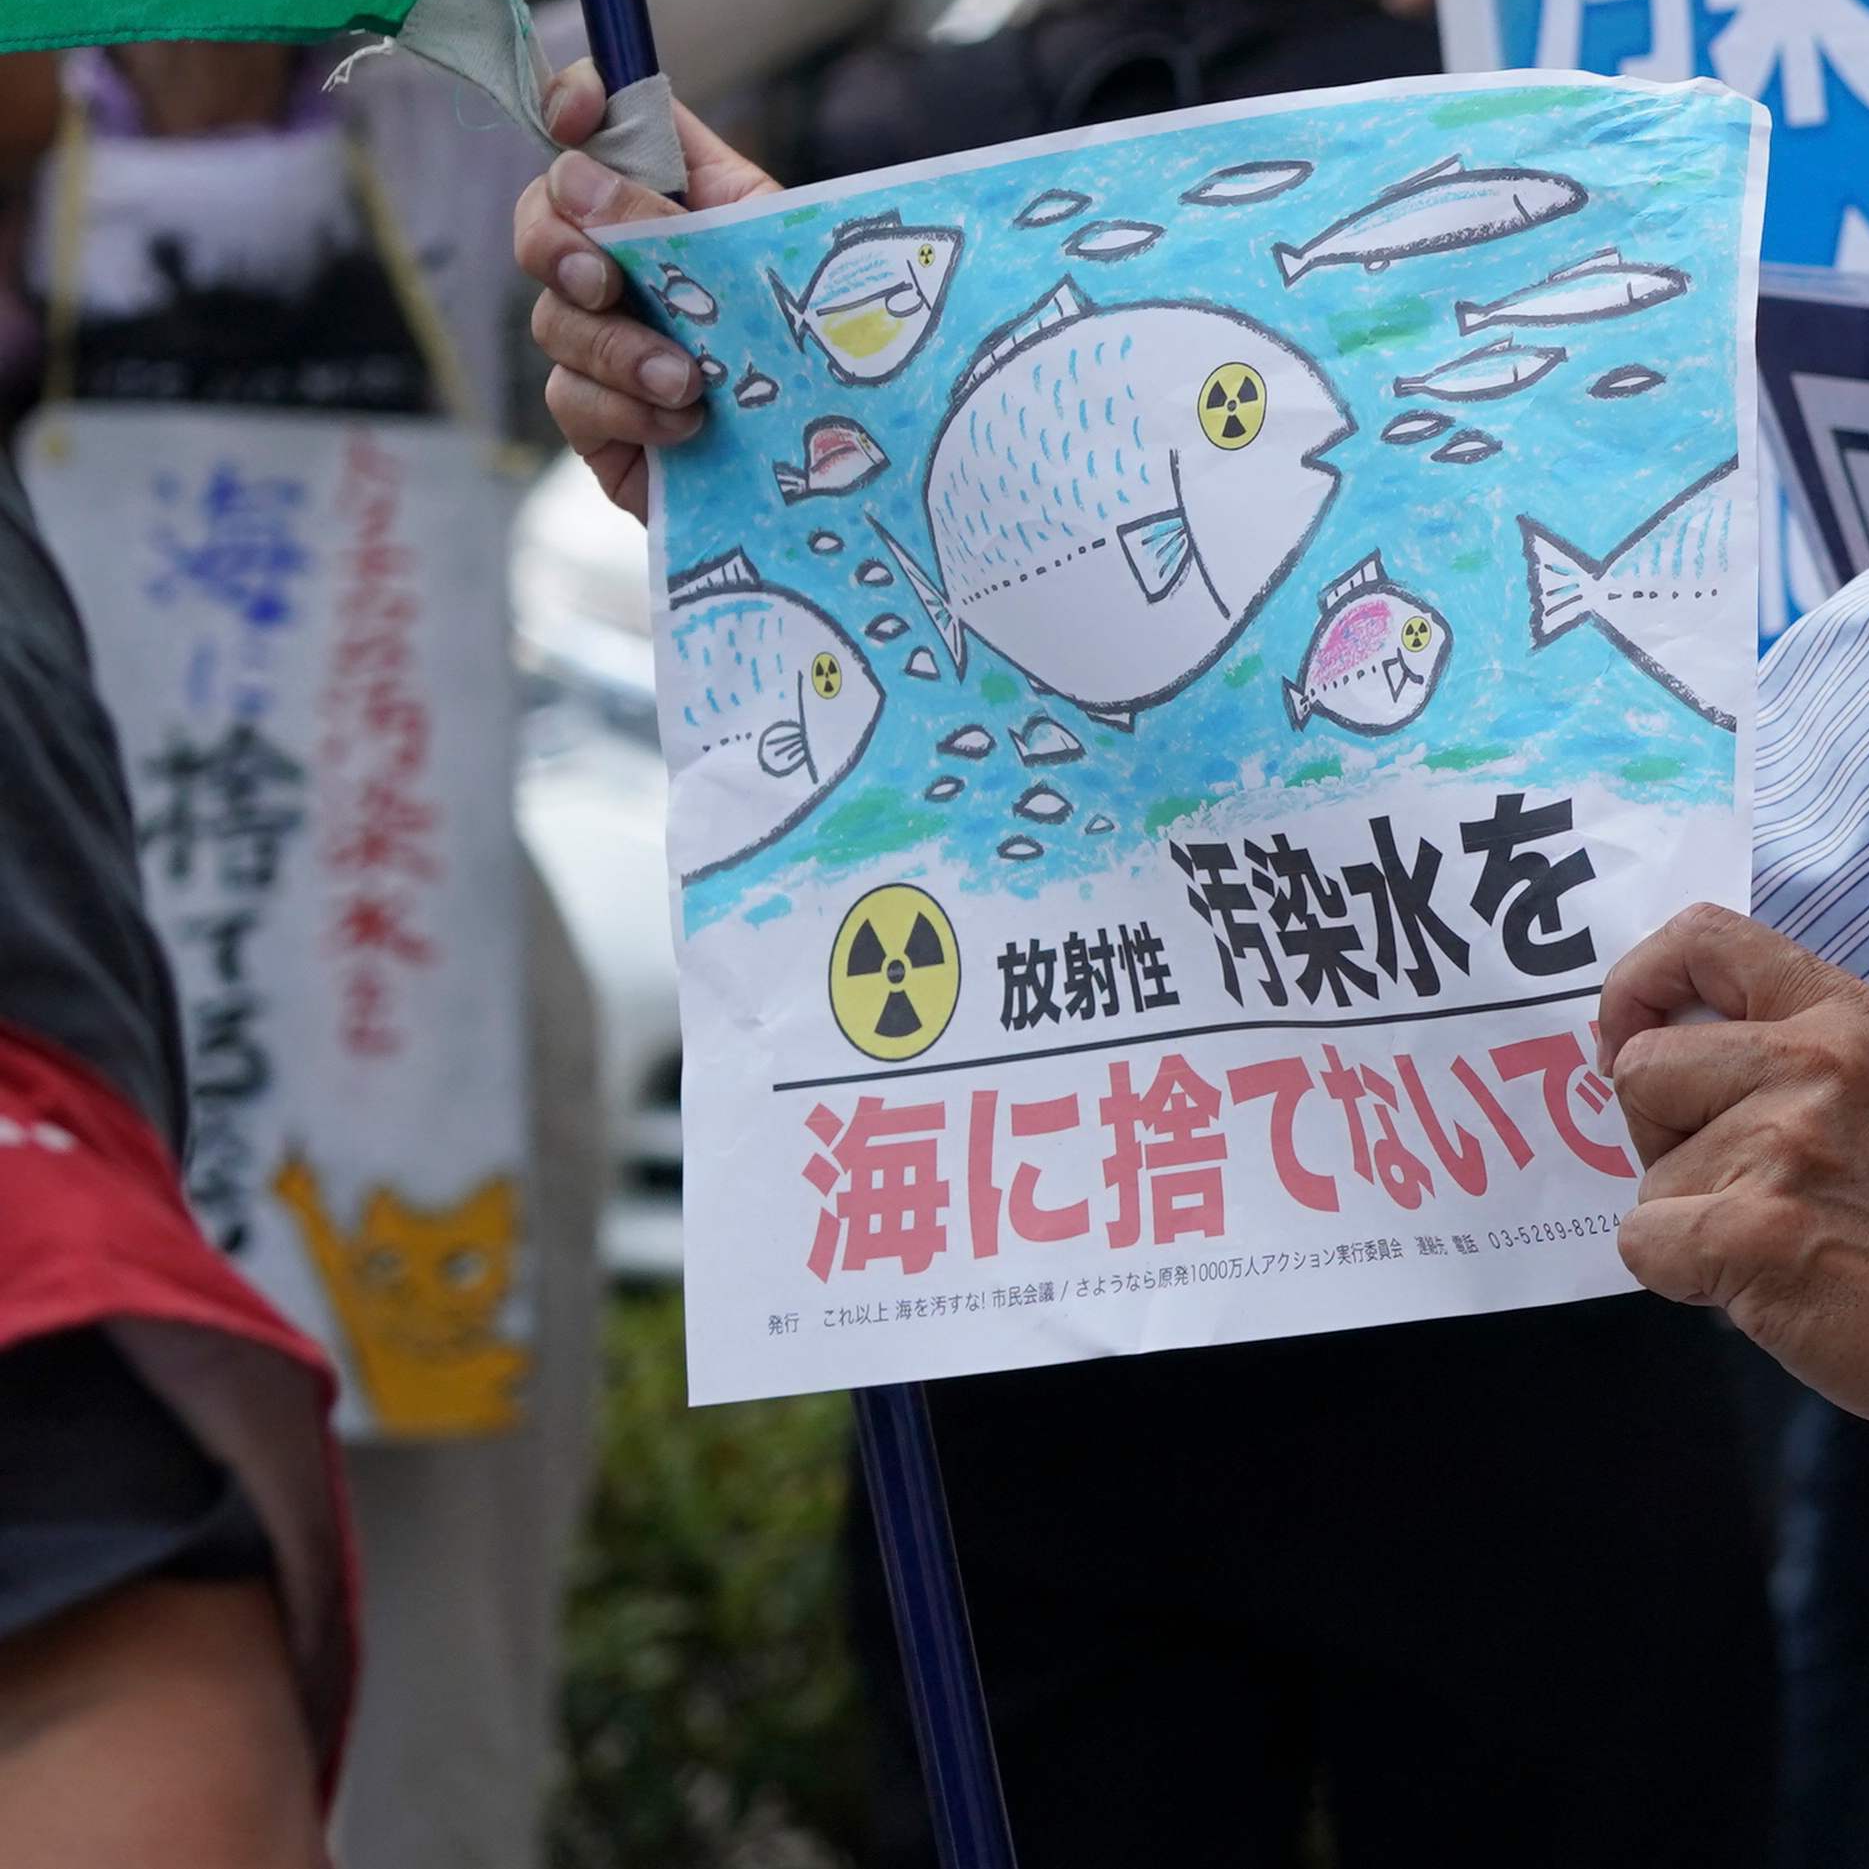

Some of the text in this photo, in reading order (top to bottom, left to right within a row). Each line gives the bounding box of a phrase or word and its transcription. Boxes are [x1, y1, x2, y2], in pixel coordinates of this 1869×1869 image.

[996, 792, 1598, 1032] 放射性 汚染水を
[803, 1019, 1638, 1284] 海に捨てないで
[768, 1312, 800, 1336] 発行
[823, 1301, 889, 1328] これ以上
[992, 1280, 1055, 1310] 市民会議
